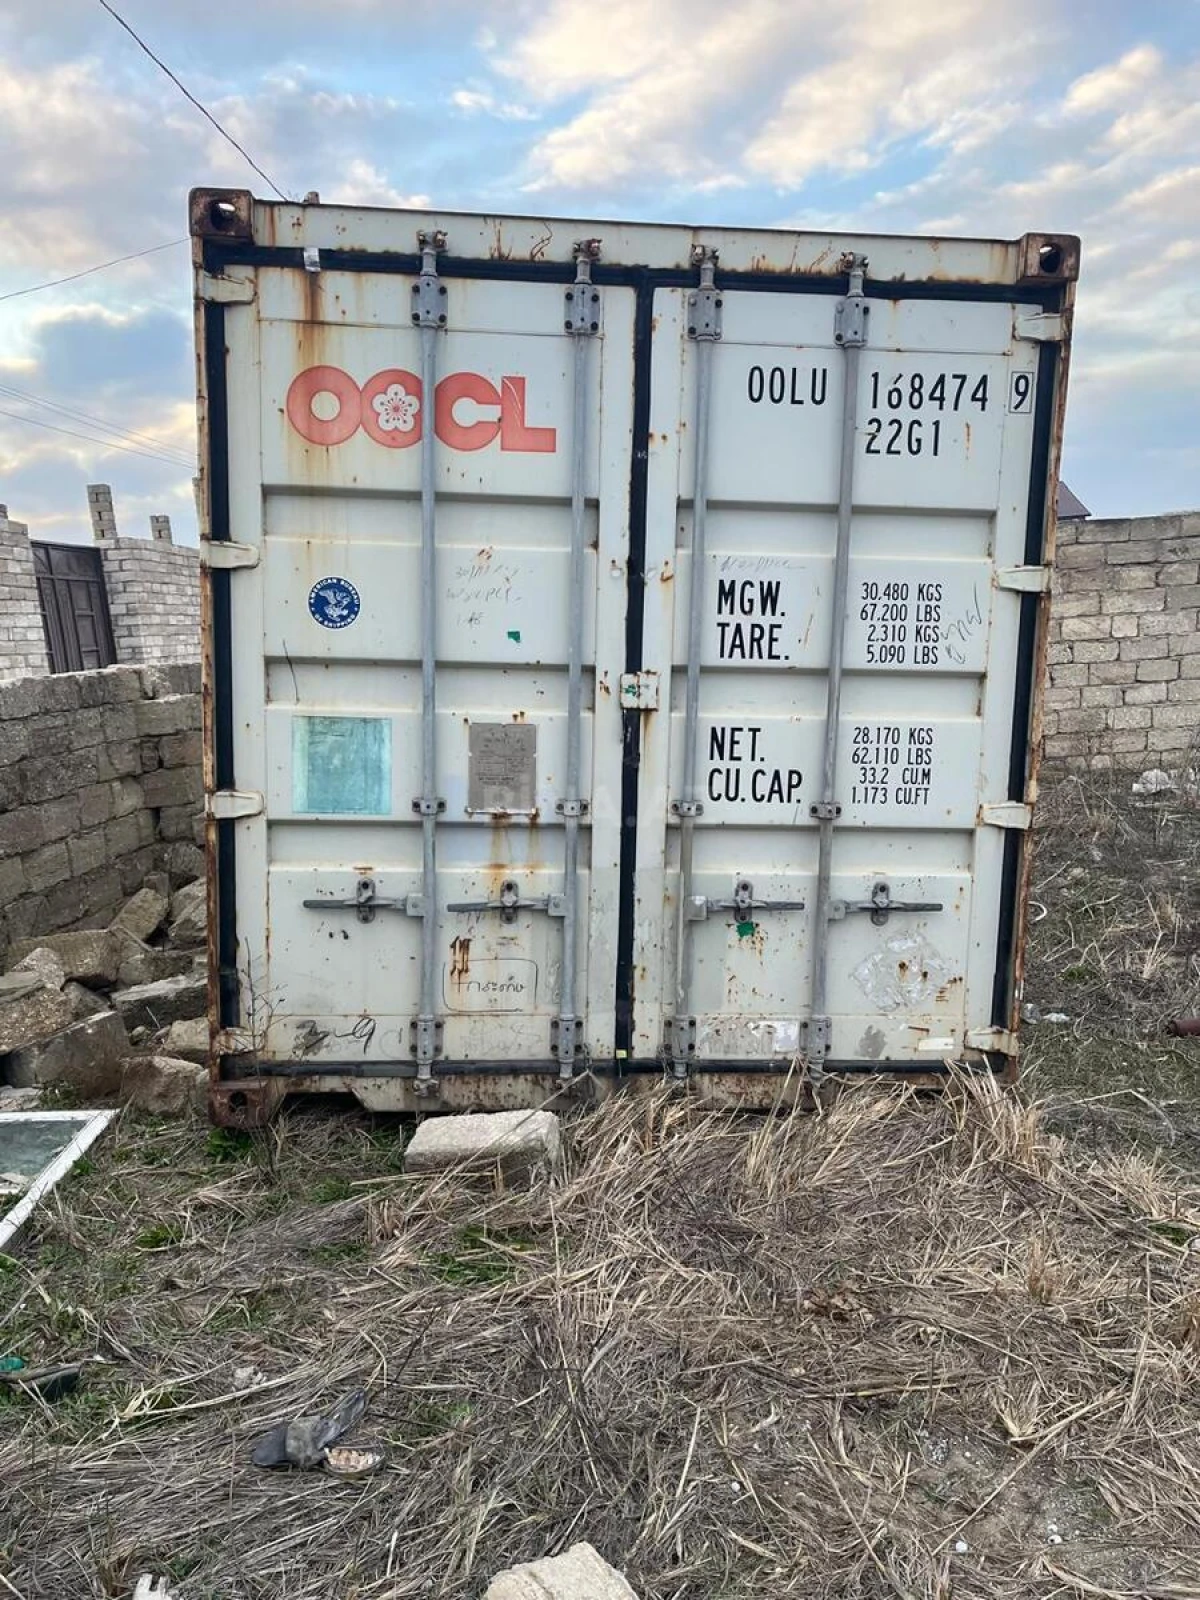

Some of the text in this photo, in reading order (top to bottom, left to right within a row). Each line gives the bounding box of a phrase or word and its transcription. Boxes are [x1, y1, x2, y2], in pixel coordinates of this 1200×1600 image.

[748, 366, 1031, 411] OOLU 168474 9
[287, 366, 556, 452] OOCL
[865, 418, 940, 456] 22G1
[717, 580, 785, 616] MGW.
[918, 584, 942, 601] KGS
[860, 603, 940, 622] 67.200 LBS
[717, 623, 789, 660] TARE.
[868, 624, 939, 643] 2.310 KGS
[867, 645, 938, 664] 5.090 LBS
[710, 727, 764, 761] NET.
[853, 727, 932, 745] 28.170 KGS
[852, 747, 931, 765] 62.110 LBS
[860, 767, 931, 785] 33.2 CU.M
[852, 787, 929, 804] 1.173 CU.FT
